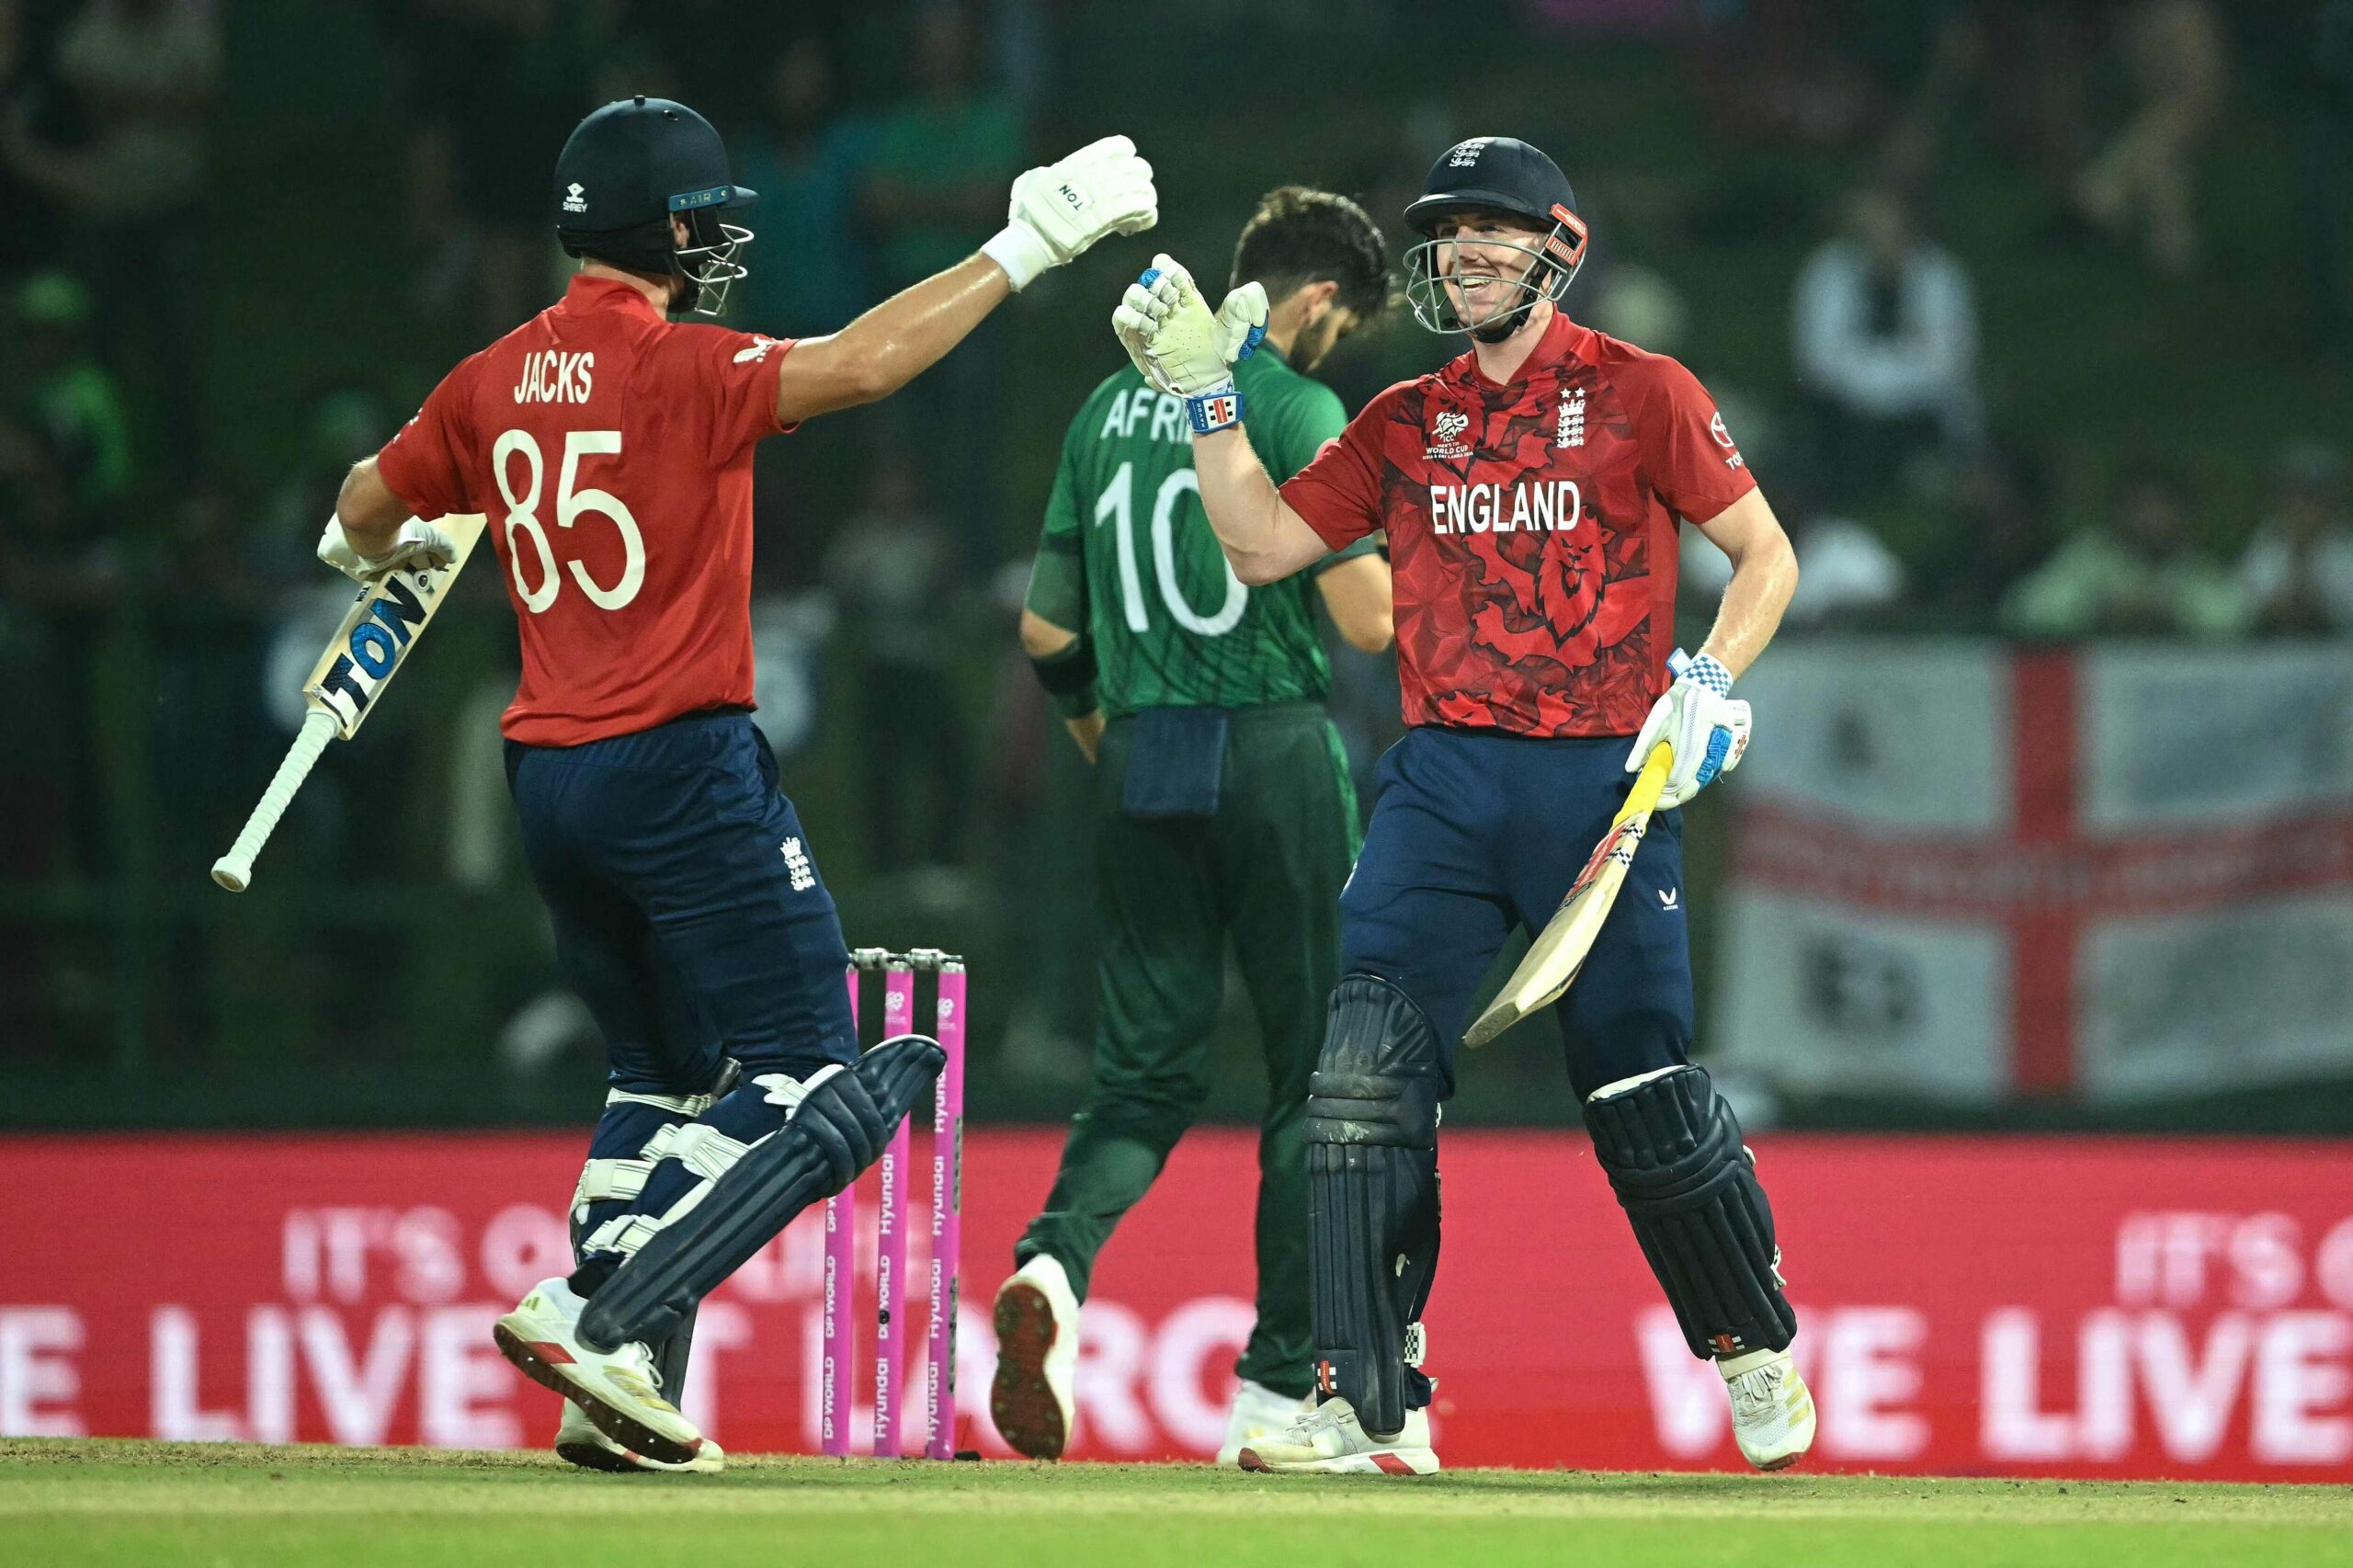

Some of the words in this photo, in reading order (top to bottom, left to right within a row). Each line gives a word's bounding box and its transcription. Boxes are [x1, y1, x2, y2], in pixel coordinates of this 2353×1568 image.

[563, 201, 588, 213] SHREY
[690, 192, 711, 206] AIR
[1058, 184, 1084, 211] TON
[514, 349, 595, 404] JACKS
[1100, 387, 1195, 446] AFRI
[1442, 435, 1455, 443] ICC
[1426, 447, 1454, 455] WORLD
[1455, 444, 1469, 453] CUP
[492, 428, 646, 614] 85
[1430, 481, 1581, 535] ENGLAND
[1094, 461, 1249, 637] 10
[355, 585, 371, 602] TON
[321, 574, 427, 713] TON
[881, 1154, 895, 1234] Hyundai
[931, 1155, 945, 1235] Hyundai
[283, 1206, 462, 1301] IT'S
[2116, 1210, 2301, 1309] IT'S
[826, 1256, 835, 1312] WORLD
[929, 1258, 943, 1338] Hyundai
[825, 1312, 835, 1338] DP
[150, 1303, 526, 1448] LIVE
[824, 1357, 834, 1410] WORLD
[875, 1358, 889, 1438] Hyundai
[926, 1361, 939, 1440] Hyundai
[1981, 1307, 2353, 1463] LIVE
[824, 1412, 833, 1439] DP
